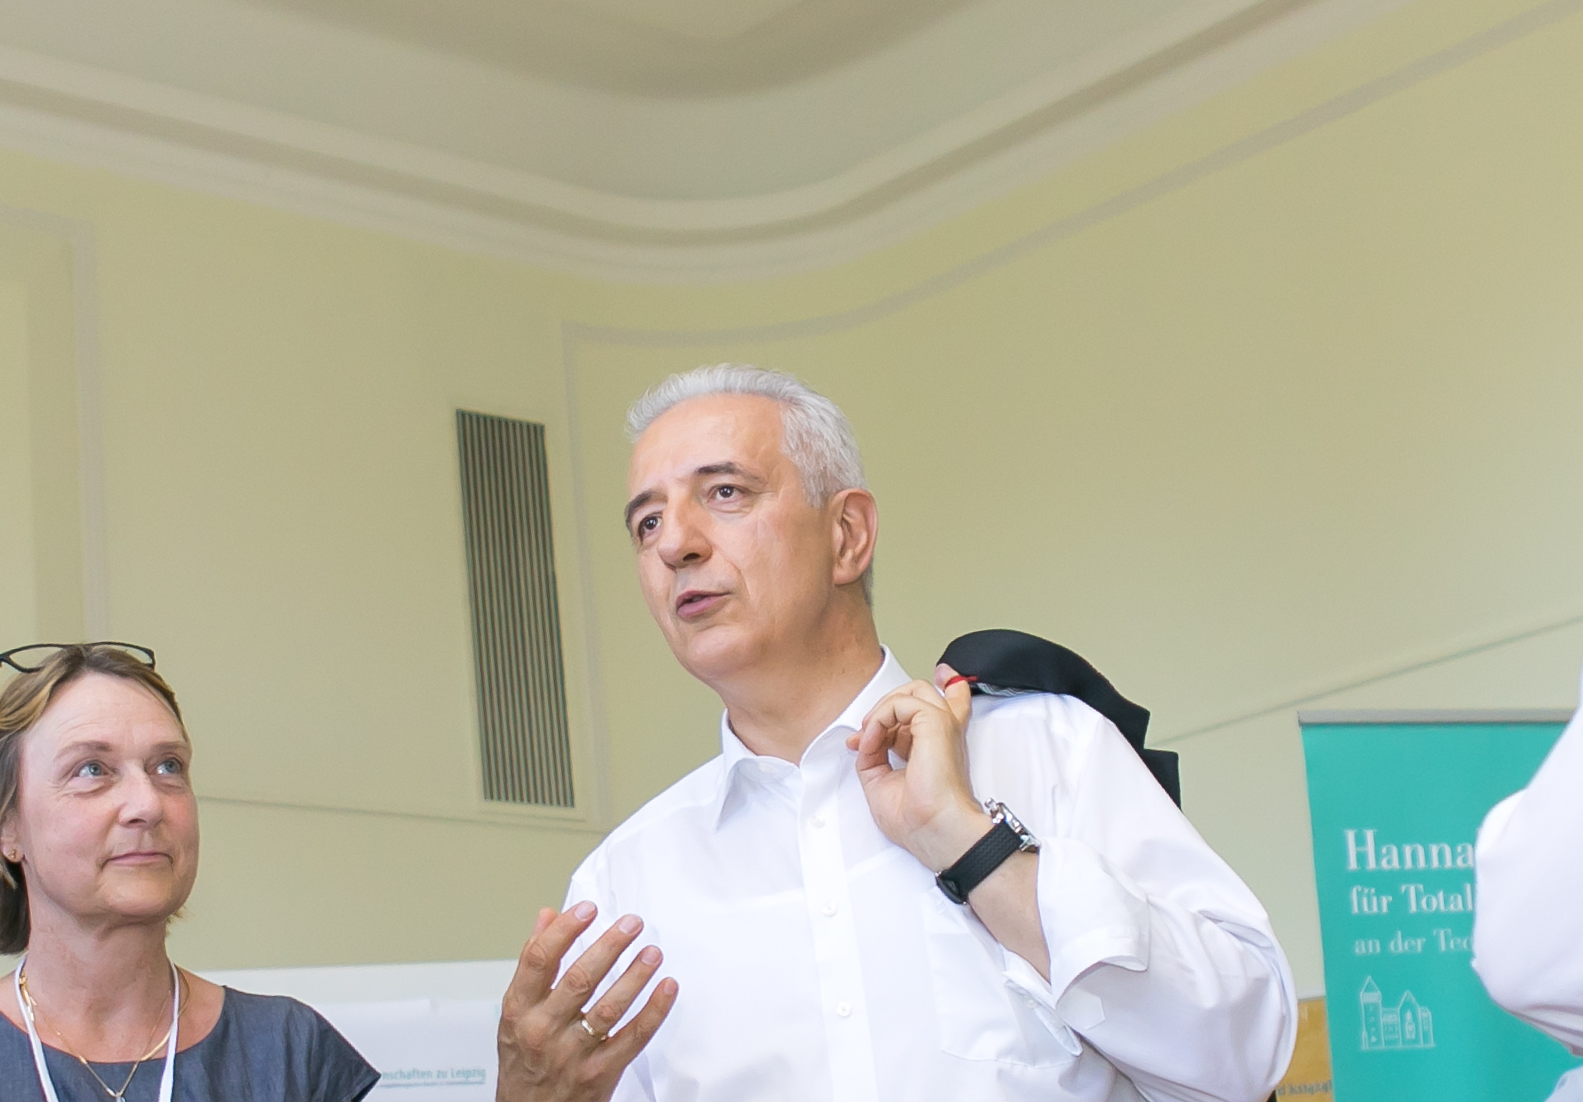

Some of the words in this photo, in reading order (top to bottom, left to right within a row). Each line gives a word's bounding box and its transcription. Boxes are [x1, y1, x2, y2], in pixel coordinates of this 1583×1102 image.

[1344, 828, 1474, 871] Hanna
[1351, 885, 1392, 915] für
[1402, 883, 1473, 914] Total
[1354, 938, 1381, 955] an
[1390, 930, 1425, 955] der
[451, 1066, 485, 1085] Leipzig
